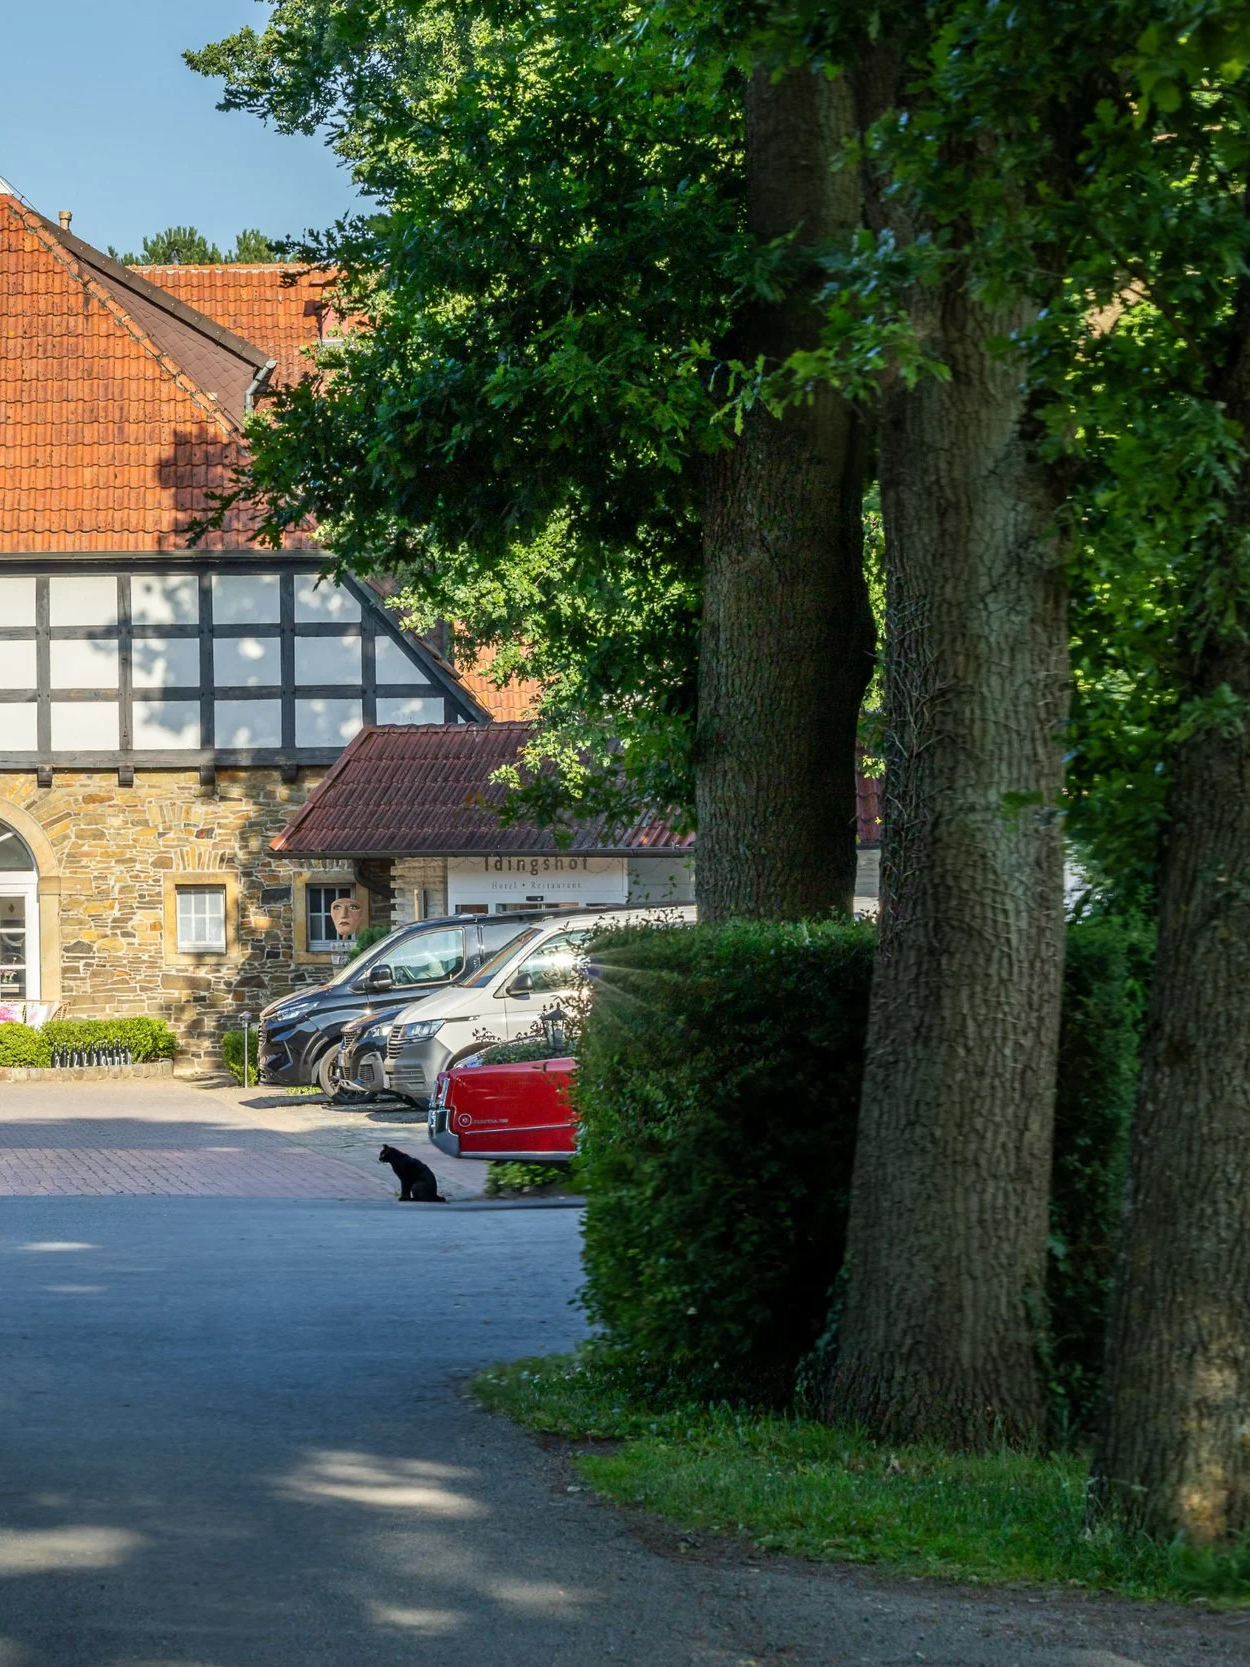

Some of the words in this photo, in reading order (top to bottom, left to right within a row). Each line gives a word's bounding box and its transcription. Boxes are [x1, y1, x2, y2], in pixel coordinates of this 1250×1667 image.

[485, 856, 588, 876] Idingshof
[492, 881, 517, 889] Hotel
[531, 881, 582, 889] Restaurant
